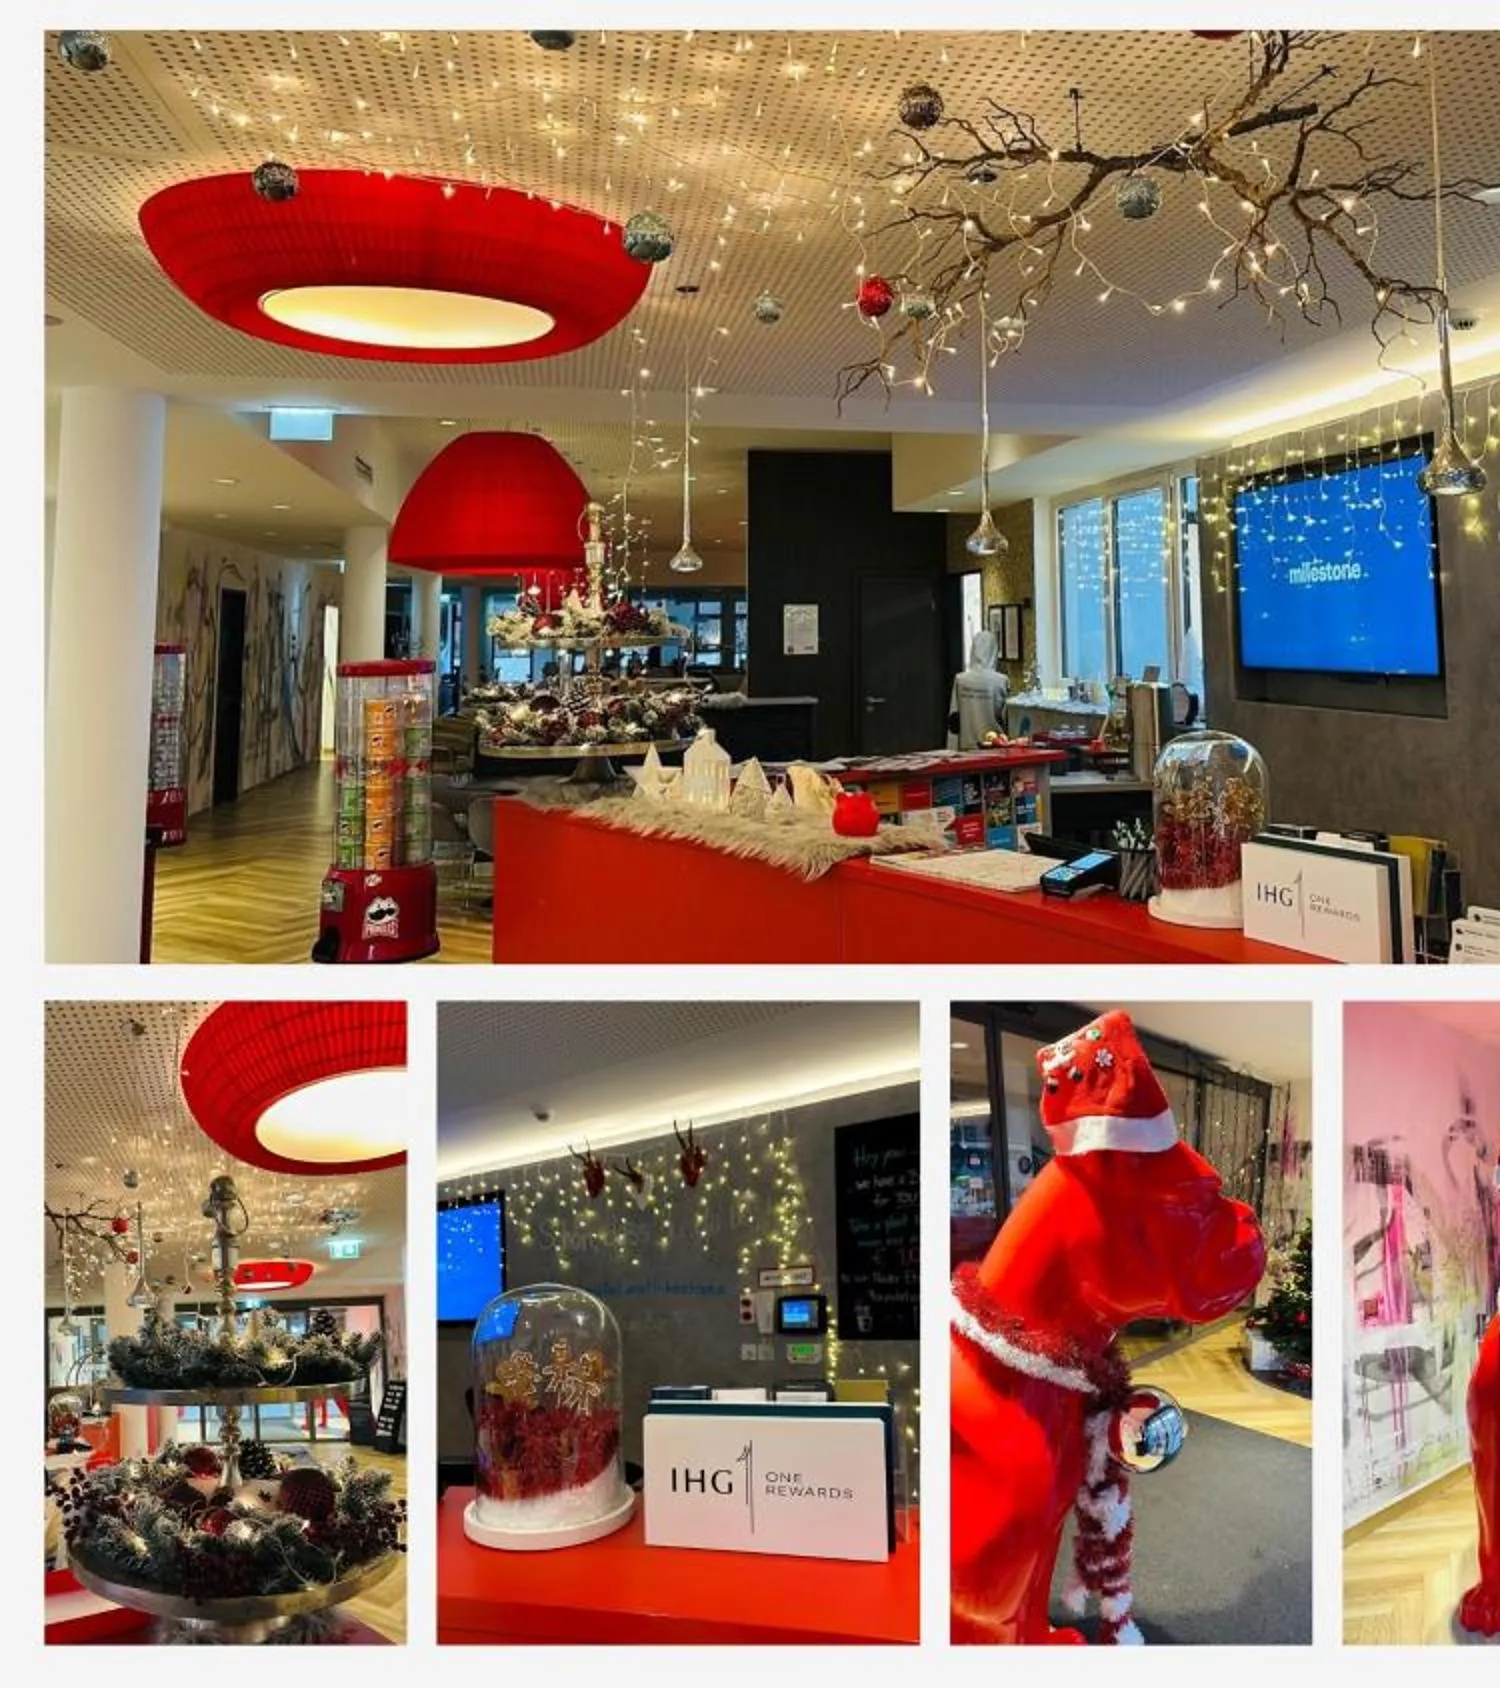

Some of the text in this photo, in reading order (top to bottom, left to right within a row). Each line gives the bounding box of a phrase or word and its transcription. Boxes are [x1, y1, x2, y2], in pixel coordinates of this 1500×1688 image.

[1288, 561, 1361, 584] milestone
[1257, 881, 1293, 907] IHG
[671, 1467, 733, 1495] IHG
[765, 1471, 802, 1483] ONE
[765, 1485, 854, 1500] REWARDS
